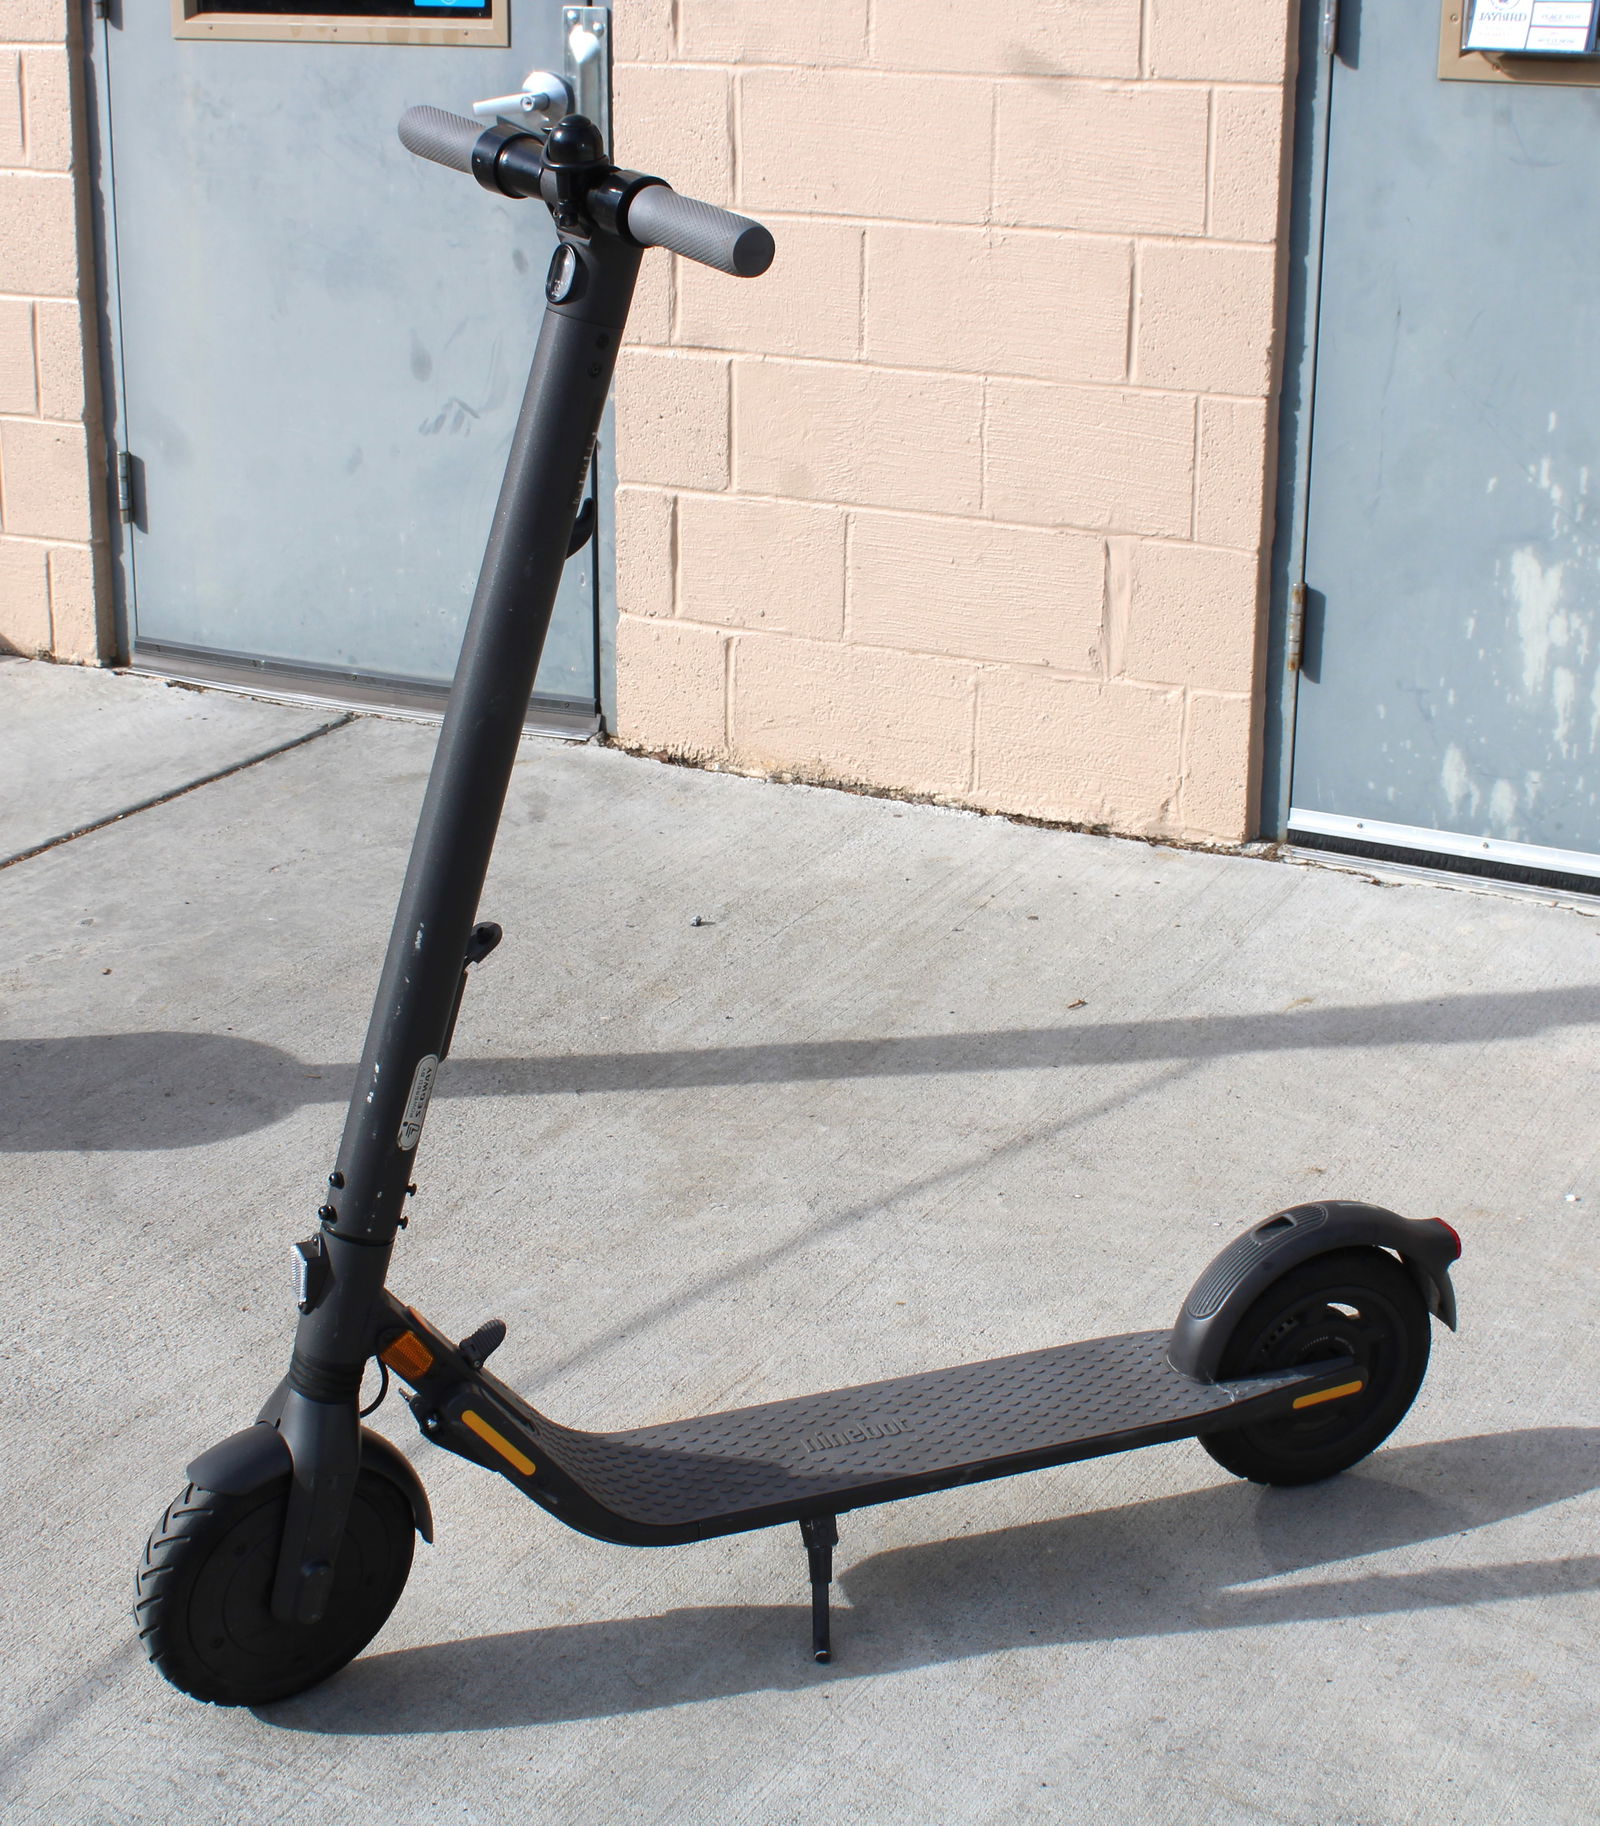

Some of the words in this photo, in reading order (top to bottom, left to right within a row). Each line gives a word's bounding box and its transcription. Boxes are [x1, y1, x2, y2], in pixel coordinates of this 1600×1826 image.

[1479, 11, 1527, 22] JAYBIRD
[415, 1067, 433, 1118] SEGWAY
[800, 1417, 916, 1452] ninebot
